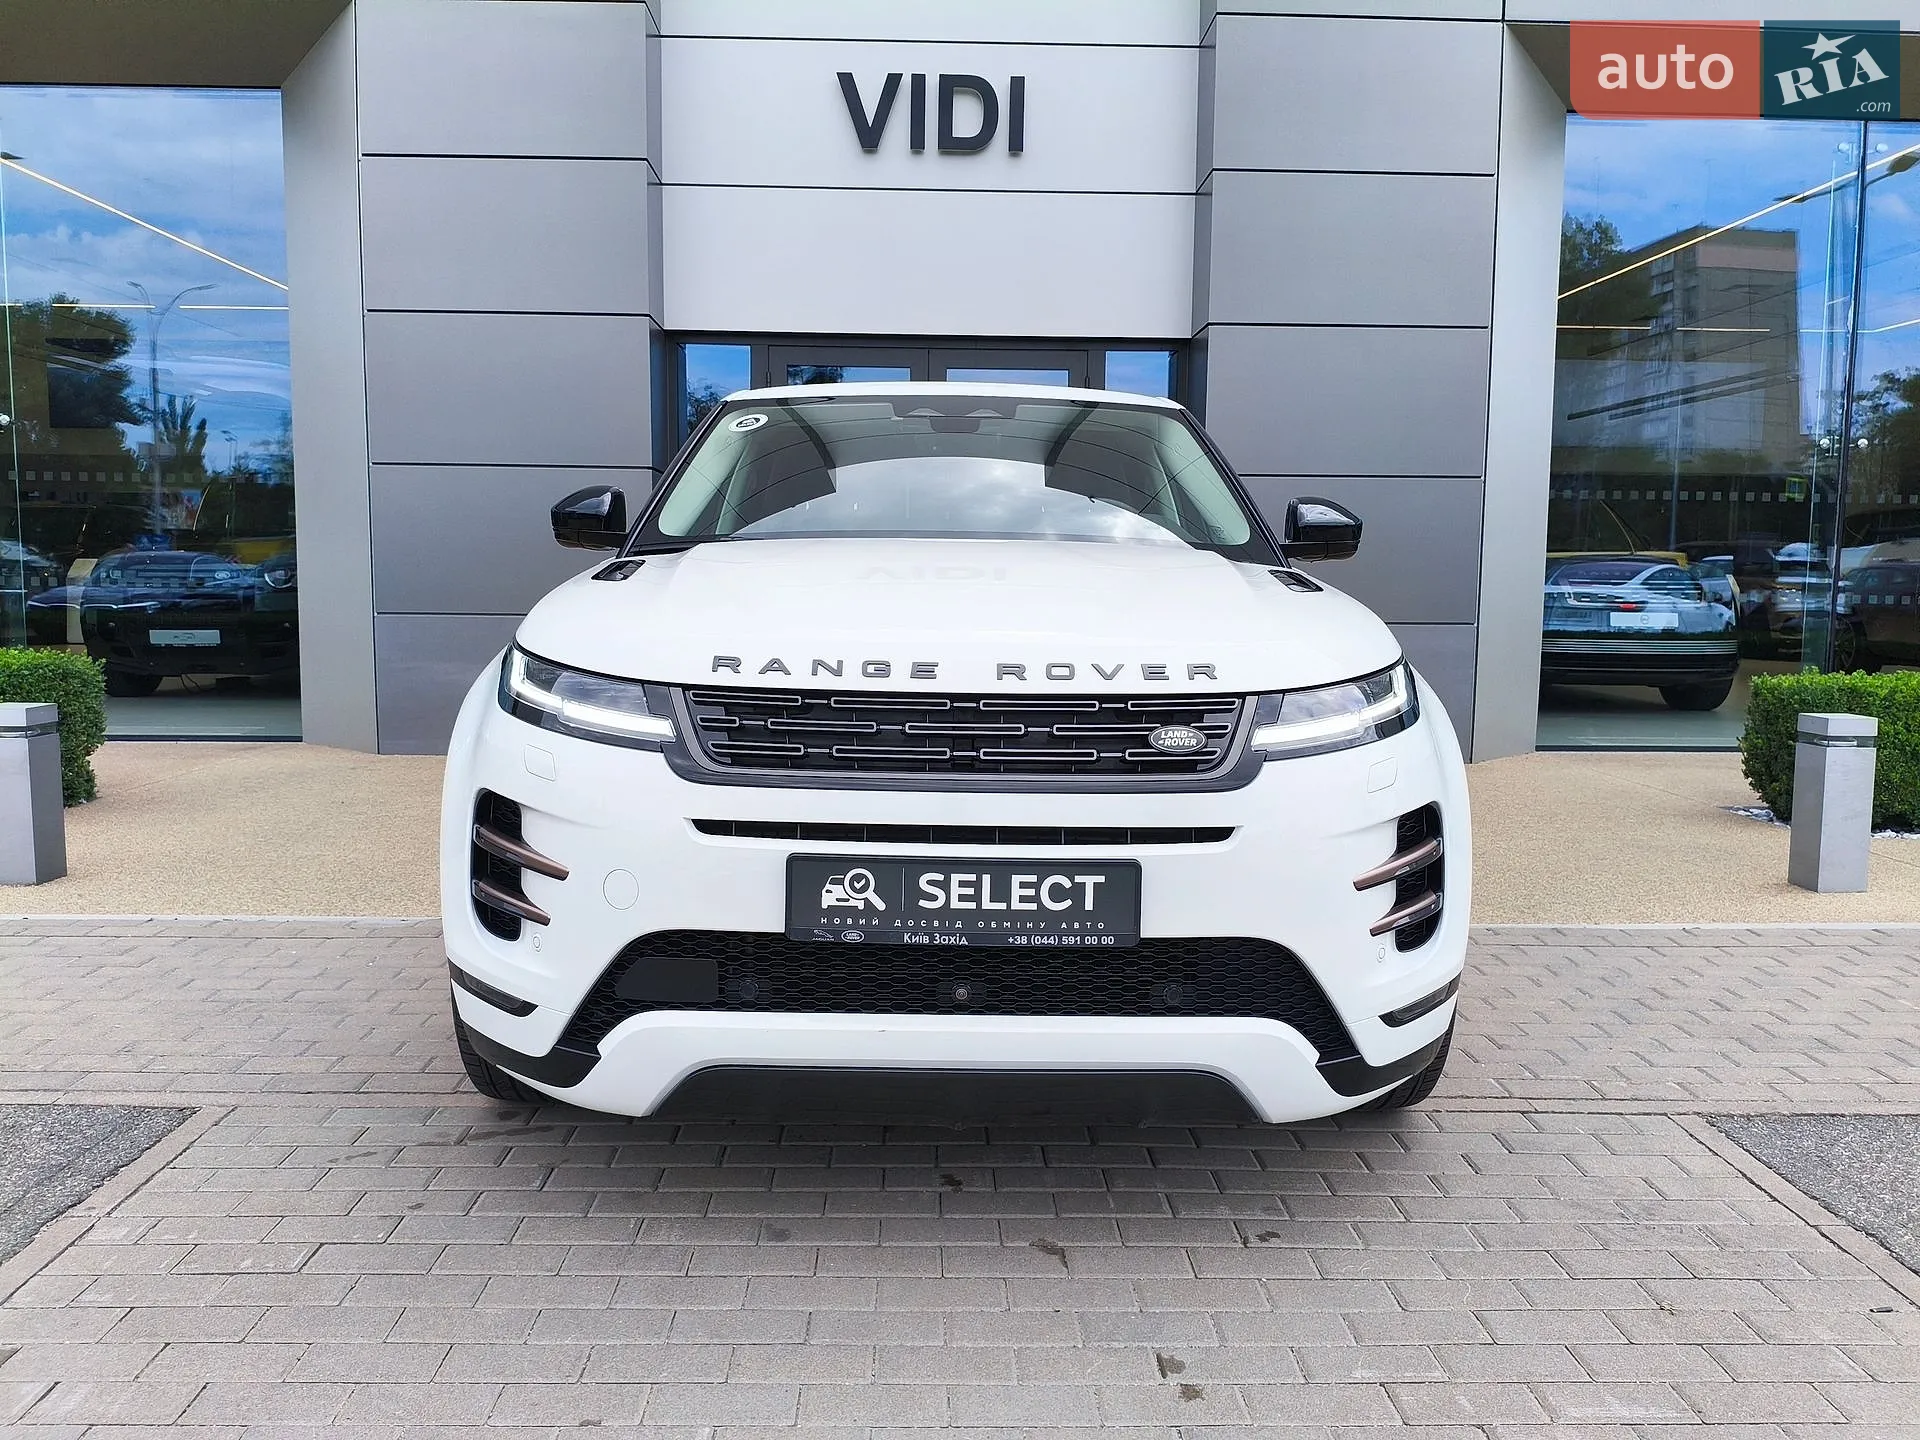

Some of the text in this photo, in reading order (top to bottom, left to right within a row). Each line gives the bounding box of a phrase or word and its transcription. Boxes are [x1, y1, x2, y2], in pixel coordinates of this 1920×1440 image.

[836, 71, 1026, 153] VIDI
[711, 655, 1218, 682] RANGE ROVER
[1161, 730, 1188, 739] LAND
[1163, 738, 1197, 747] ROVER
[917, 871, 1106, 911] SELECT
[820, 917, 1105, 930] НОВИЙ ДОСВІД ОБМІНУ АВТО
[903, 931, 969, 946] Київ Захід
[1007, 934, 1115, 946] +38 (044) 591 00 00
